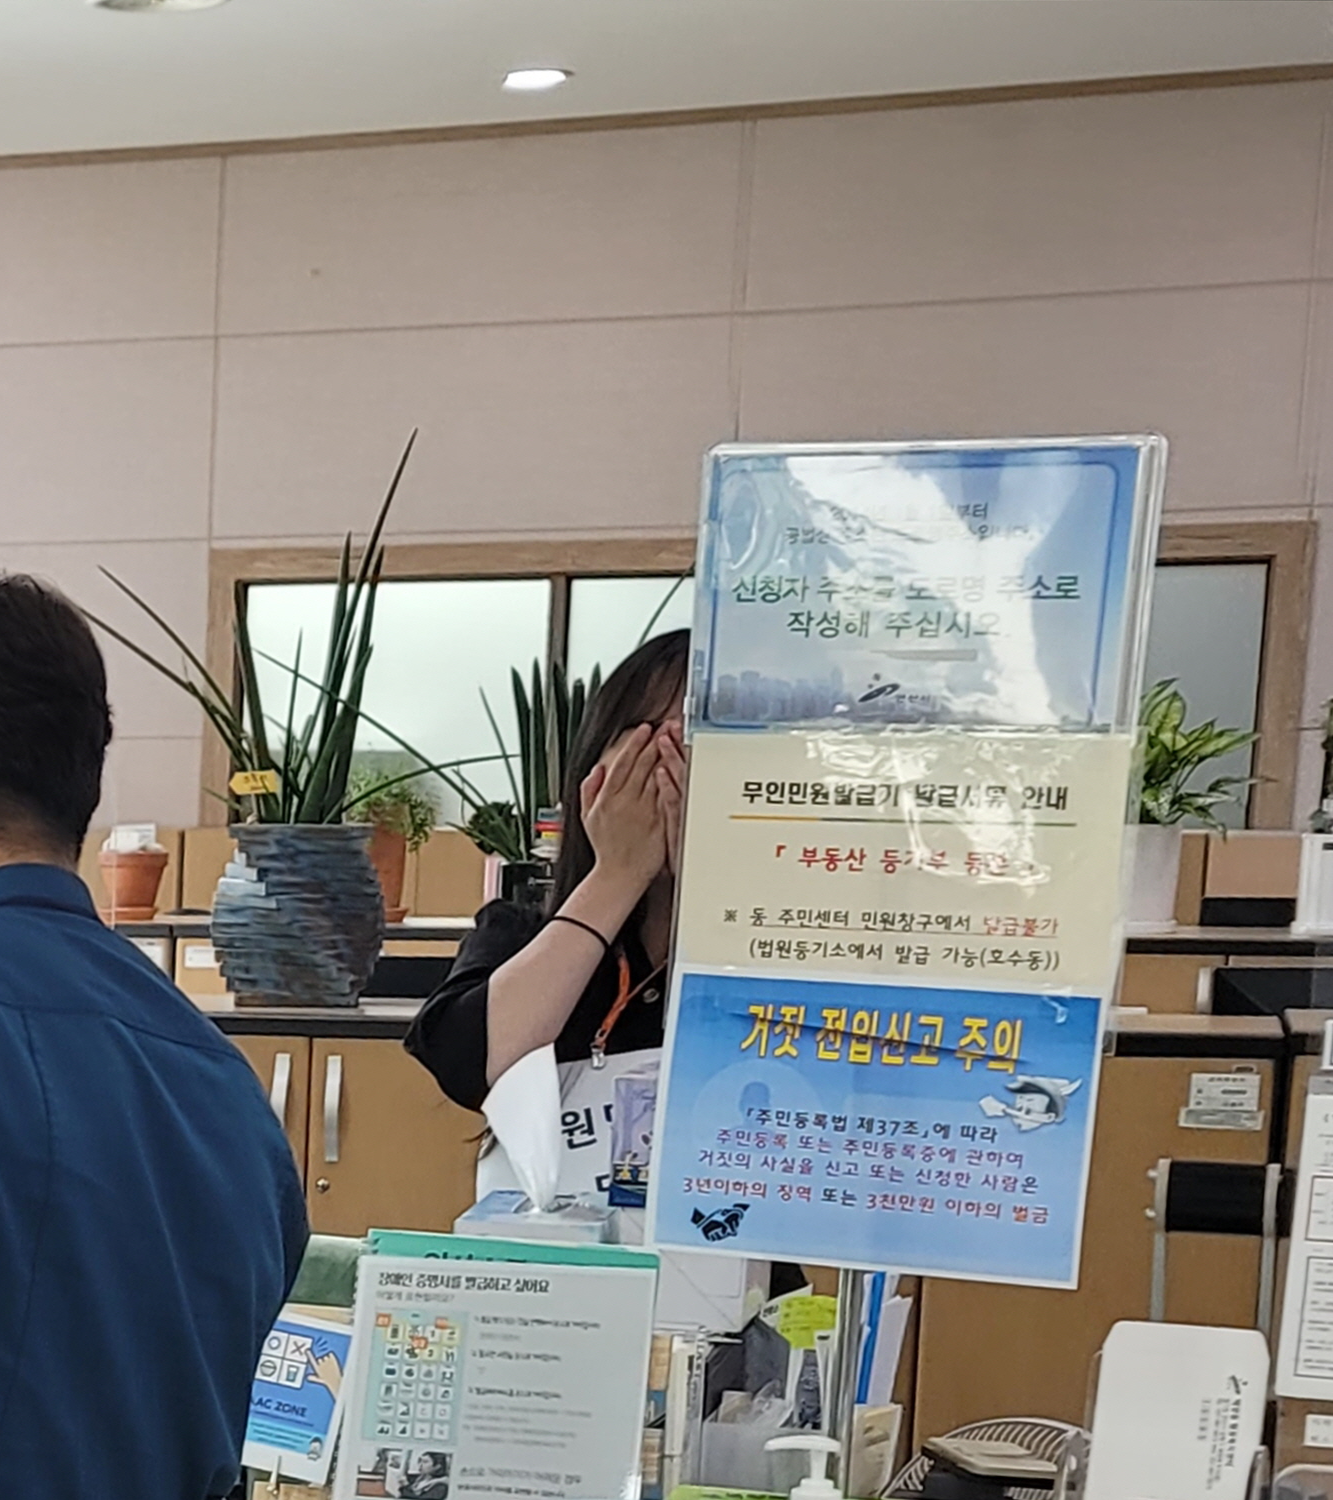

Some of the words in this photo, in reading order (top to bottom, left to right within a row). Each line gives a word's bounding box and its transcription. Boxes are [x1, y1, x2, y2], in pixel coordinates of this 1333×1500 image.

[732, 575, 810, 604] 신청자
[905, 575, 987, 602] 도로명
[995, 574, 1082, 601] 주소로
[786, 610, 871, 639] 작성해
[741, 781, 901, 808] 무인민원발급기
[1021, 785, 1069, 811] 안내
[797, 847, 867, 873] 부동산
[749, 907, 767, 927] 동
[778, 909, 850, 929] 주민센터
[861, 911, 971, 933] 민원창구에서
[983, 915, 1059, 937] 발급불가
[749, 937, 884, 961] (법원등기소에서
[894, 944, 932, 965] 발급
[941, 946, 1061, 972] 가능(호수동))
[740, 1003, 807, 1058] 거짓
[815, 1007, 946, 1066] 전입신고
[954, 1016, 1023, 1075] 주의
[716, 1128, 789, 1150] 주민등록
[797, 1134, 833, 1155] 또는
[842, 1138, 958, 1164] 주민등록증에
[965, 1149, 1024, 1169] 관하여
[959, 1124, 999, 1144] 따라
[698, 1149, 752, 1170] 거짓의
[759, 1154, 815, 1175] 사실을
[825, 1160, 860, 1178] 신고
[868, 1163, 905, 1183] 또는
[980, 1173, 1039, 1195] 사람은
[683, 1177, 768, 1199] 3년이하의
[777, 1183, 813, 1203] 징역
[820, 1187, 858, 1208] 또는
[865, 1193, 936, 1215] 3천만원
[944, 1198, 1003, 1219] 이하의
[1012, 1204, 1050, 1225] 벌금
